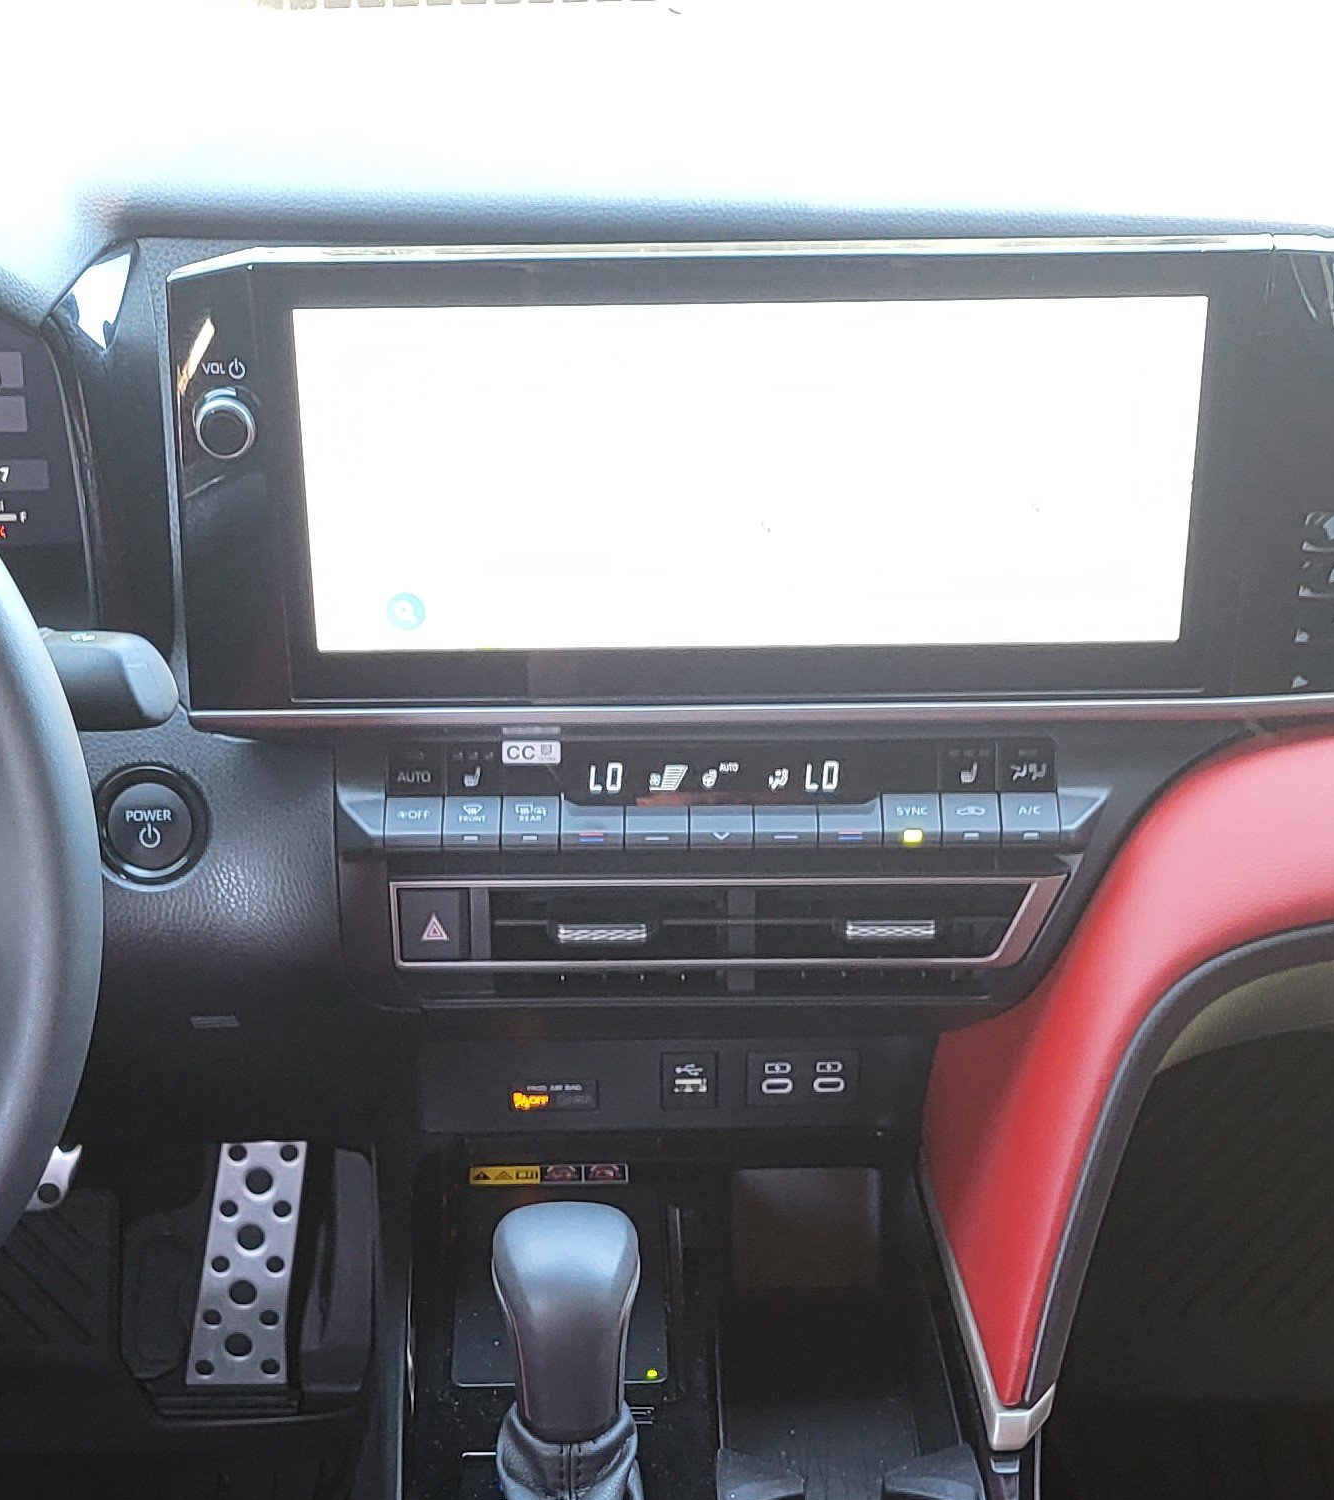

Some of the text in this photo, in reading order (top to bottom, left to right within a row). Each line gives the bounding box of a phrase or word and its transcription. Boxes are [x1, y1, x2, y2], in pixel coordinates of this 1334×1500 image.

[201, 362, 226, 376] VOL
[0, 467, 10, 483] 7
[506, 744, 536, 760] CC
[397, 771, 431, 783] AUTO
[588, 762, 624, 794] LO
[803, 760, 840, 792] LO
[125, 809, 172, 823] POWER
[407, 810, 430, 820] OFF
[896, 805, 929, 817] SYNC
[1018, 805, 1042, 816] A/C
